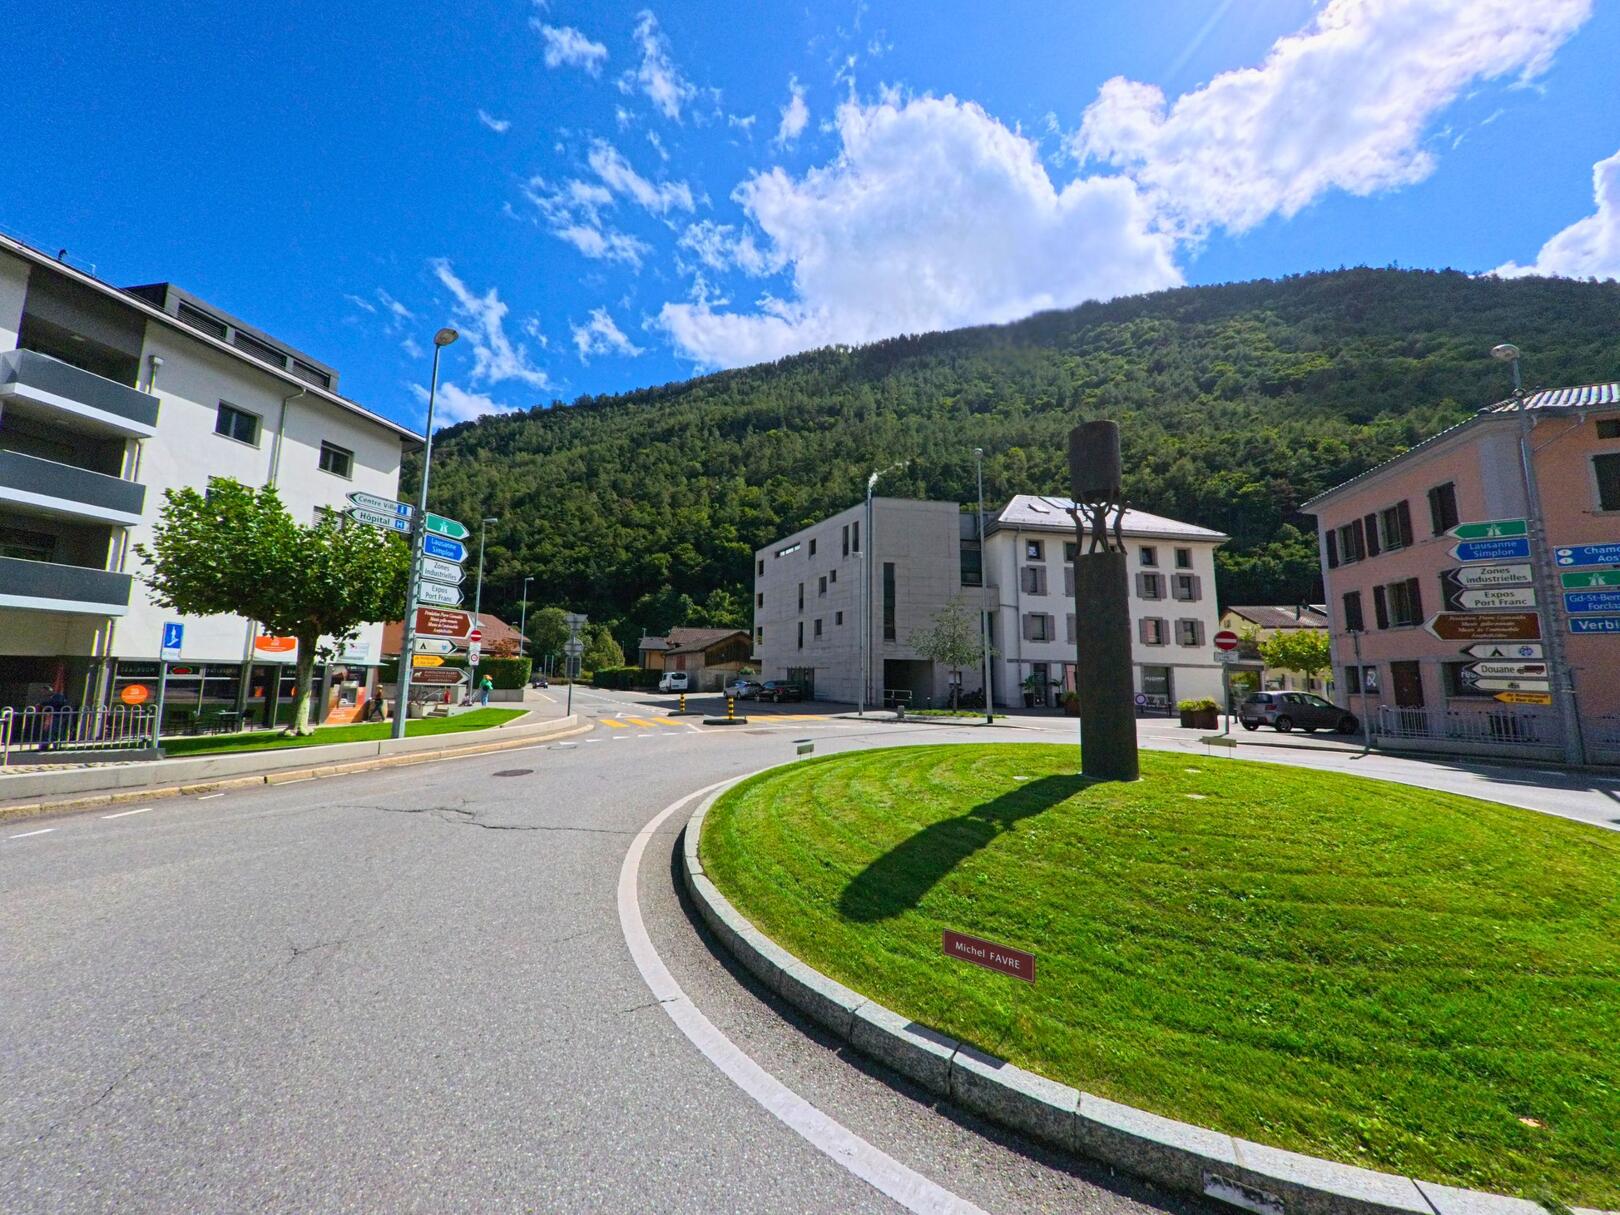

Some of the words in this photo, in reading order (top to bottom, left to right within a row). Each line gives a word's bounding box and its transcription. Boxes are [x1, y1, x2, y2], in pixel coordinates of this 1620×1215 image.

[358, 495, 381, 507] Centre
[360, 511, 390, 525] Hôpital
[431, 537, 457, 550] Lausanne
[1469, 541, 1517, 550] Lausanne
[432, 545, 455, 557] Simplon
[1473, 549, 1514, 558] Simplon
[434, 561, 451, 571] Zones
[1480, 567, 1510, 575] Zones
[1466, 573, 1528, 583] industrielles
[431, 584, 448, 595] Expos
[425, 591, 437, 600] Port
[1484, 591, 1515, 600] Expos
[1500, 598, 1528, 606] Franc
[1481, 665, 1515, 673] Douane
[955, 941, 986, 958] Michel
[989, 951, 1021, 970] FAVRE
